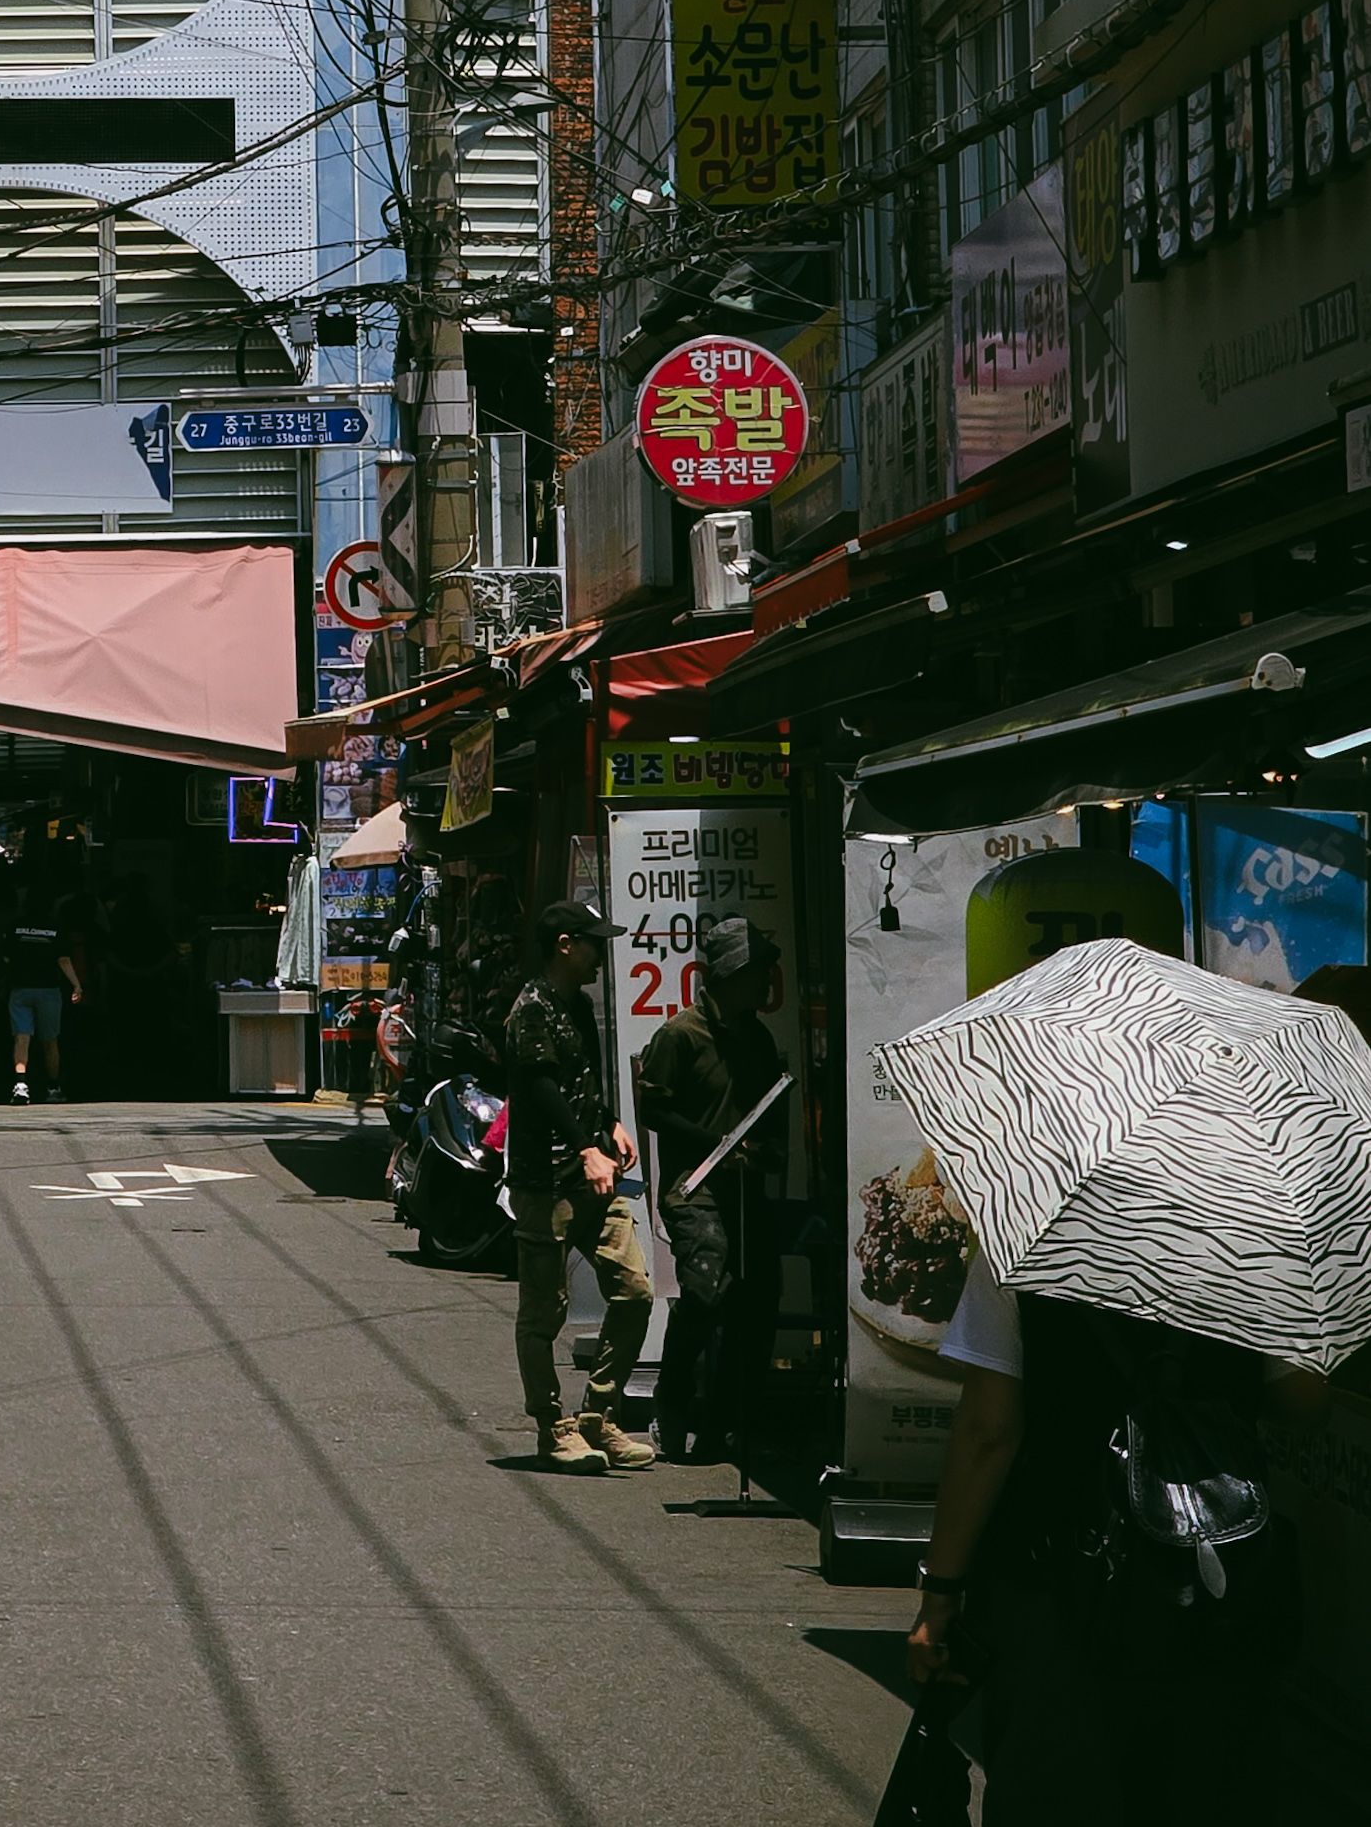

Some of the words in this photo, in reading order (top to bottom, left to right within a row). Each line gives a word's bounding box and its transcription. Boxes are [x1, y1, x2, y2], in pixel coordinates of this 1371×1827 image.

[685, 20, 826, 100] 소문난
[689, 112, 826, 194] 김밥집
[688, 347, 752, 380] 향미
[190, 423, 207, 437] 27
[222, 412, 328, 435] 중구로33번길
[342, 418, 361, 432] 23
[650, 385, 793, 453] 족발
[219, 434, 273, 447] Junggu-ro
[670, 456, 777, 488] 앞족전문
[611, 751, 664, 785] 원조
[642, 827, 759, 861] 프리미엄
[628, 867, 778, 903] 아메리카노
